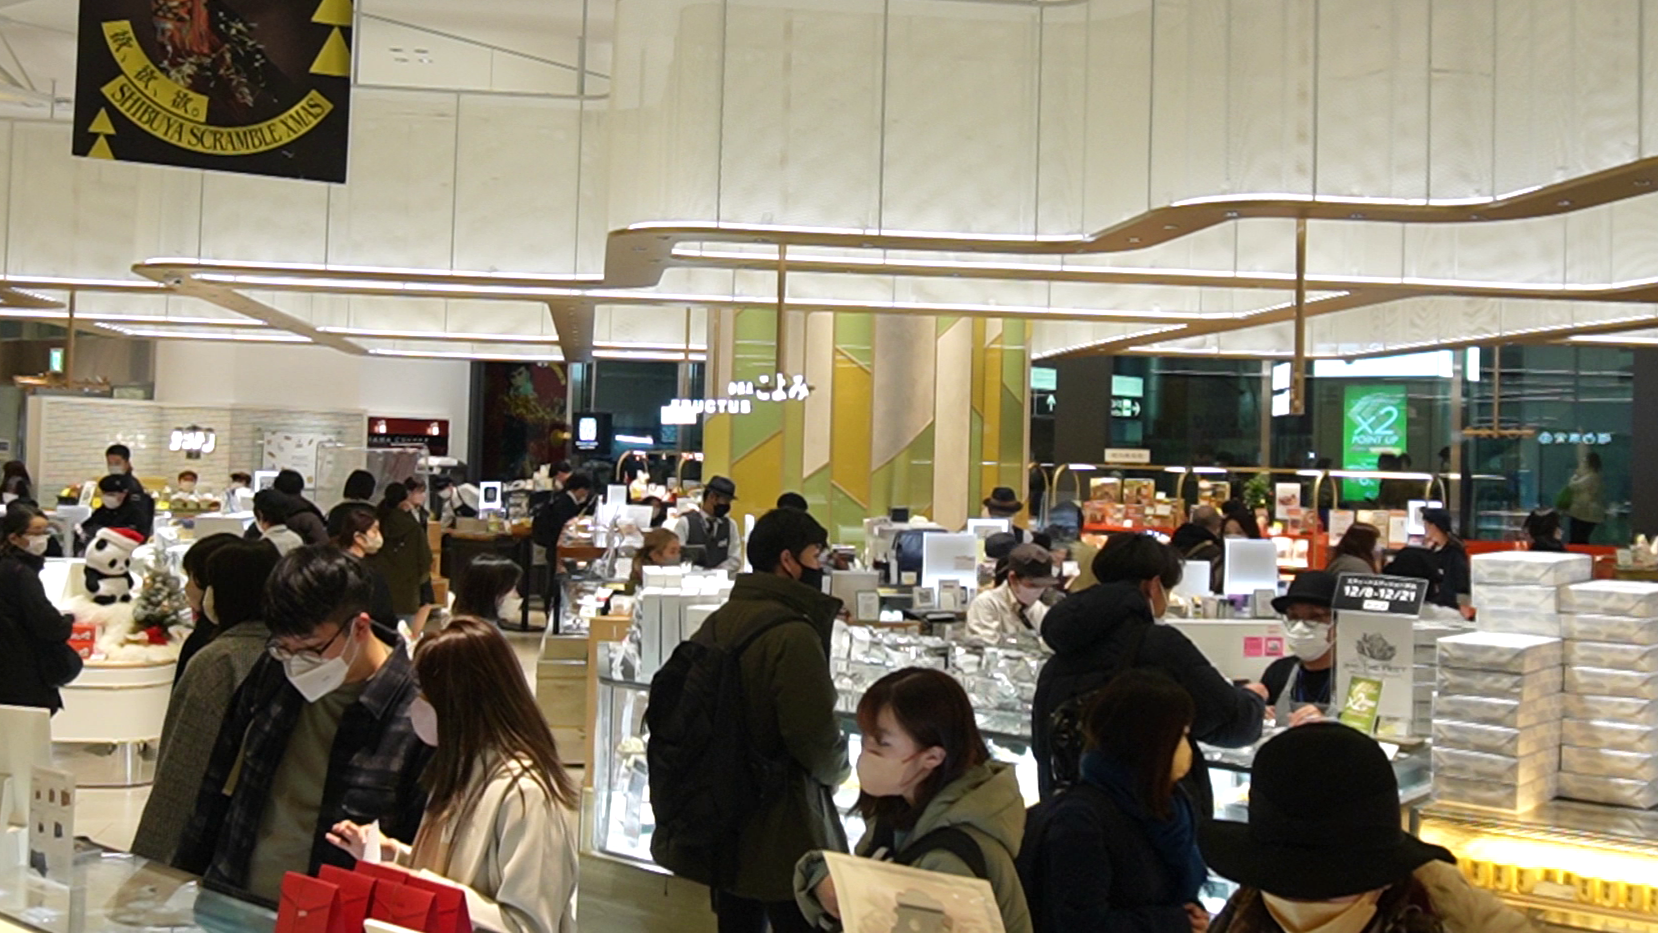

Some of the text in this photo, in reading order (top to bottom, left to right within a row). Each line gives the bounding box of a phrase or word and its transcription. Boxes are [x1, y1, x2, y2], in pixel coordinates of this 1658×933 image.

[110, 82, 326, 152] SHIBUYA SCRAMBLE XMAS
